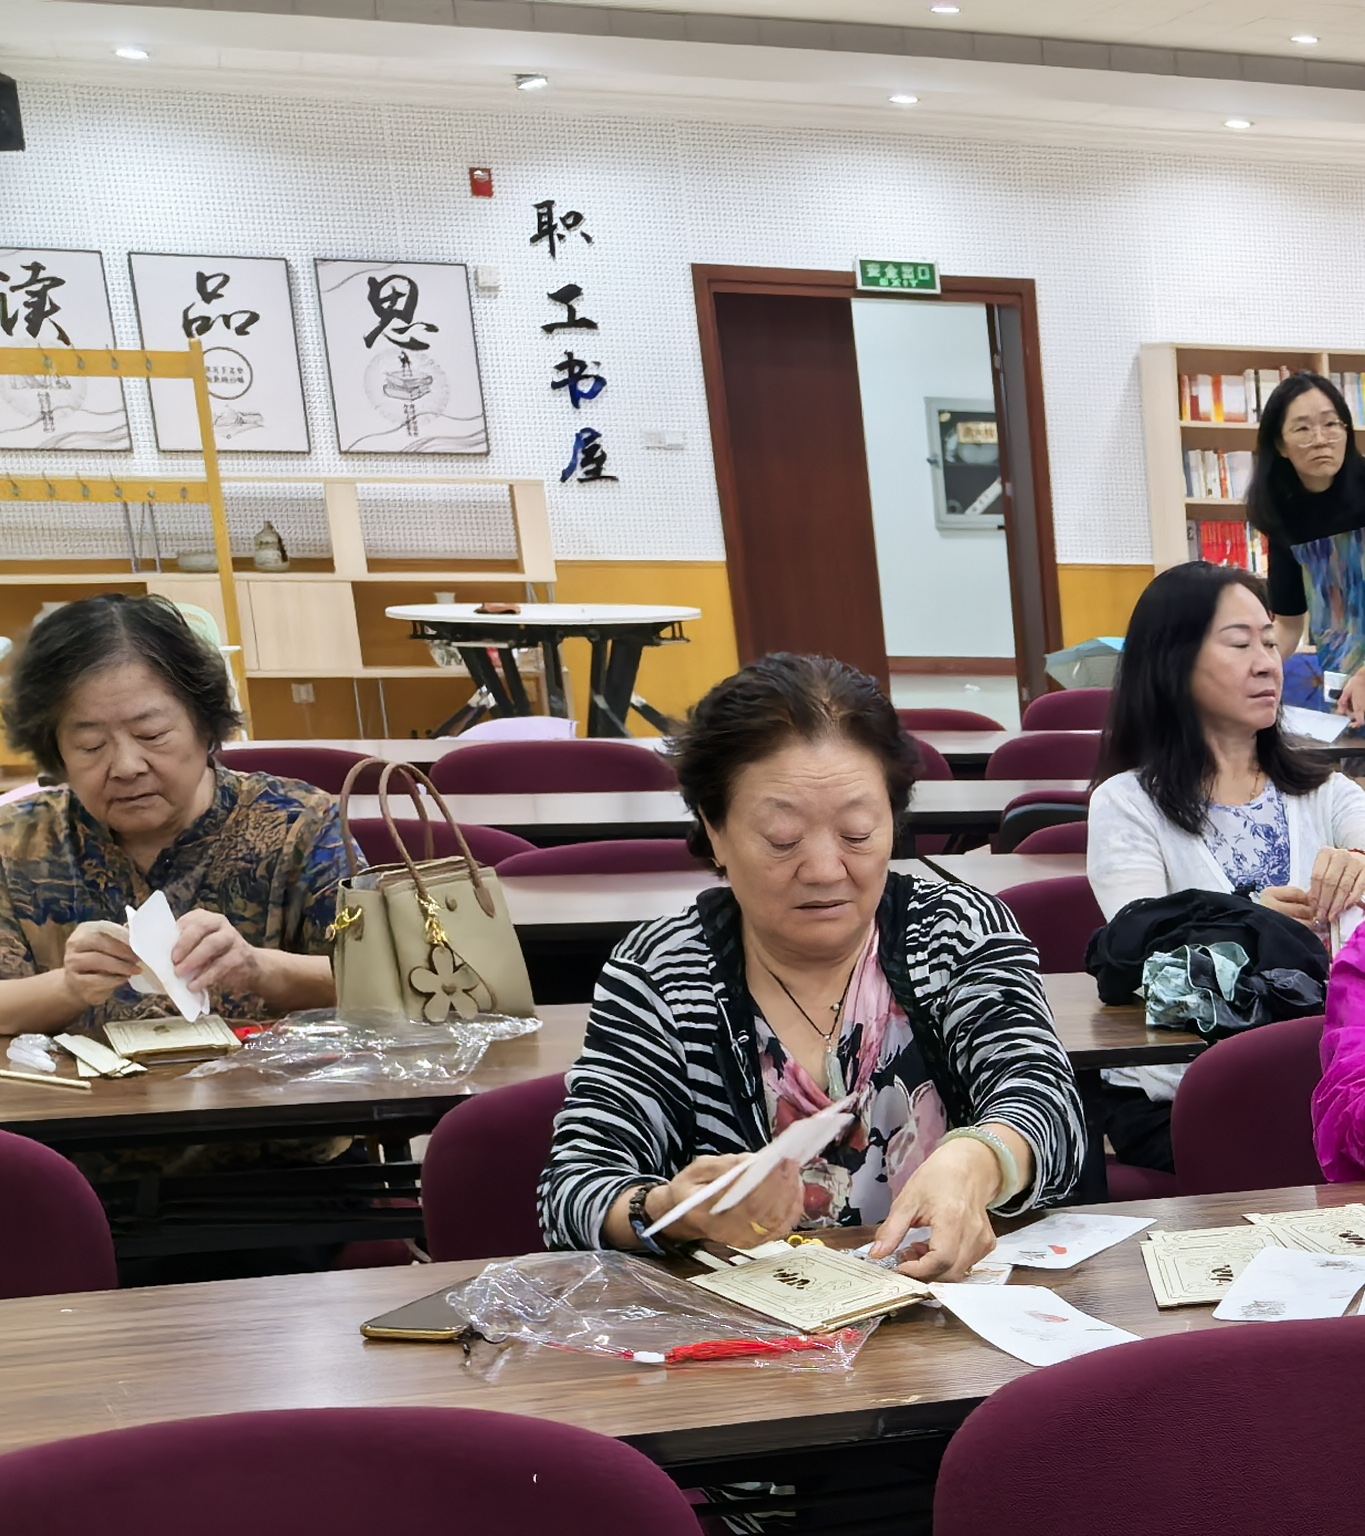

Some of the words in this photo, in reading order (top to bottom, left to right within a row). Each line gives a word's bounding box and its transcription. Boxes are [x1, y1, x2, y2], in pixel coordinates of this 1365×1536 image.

[182, 271, 260, 338] 品
[363, 274, 439, 349] 思
[529, 199, 619, 482] 职工书屋
